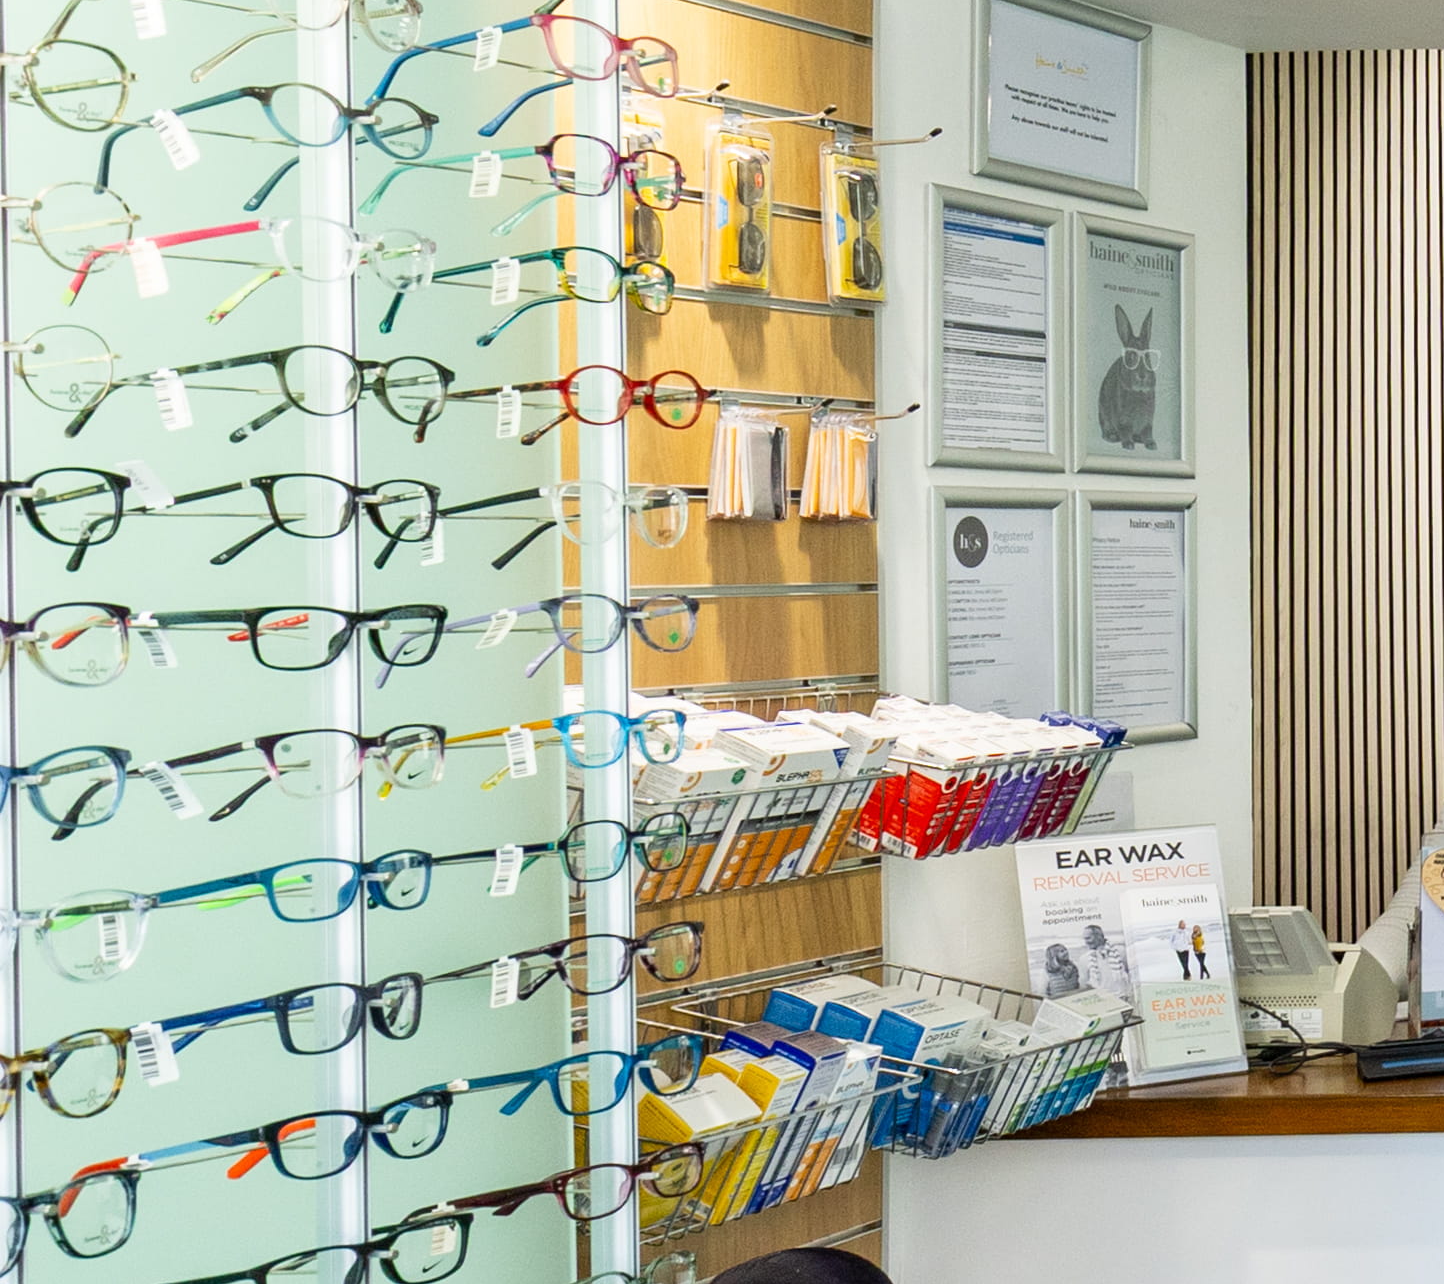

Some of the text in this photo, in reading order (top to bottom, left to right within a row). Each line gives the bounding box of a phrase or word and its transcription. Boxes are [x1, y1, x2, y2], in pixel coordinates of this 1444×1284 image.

[1056, 841, 1185, 869] EAR WAX
[1033, 862, 1212, 892] REMOVAL SERVICE
[1042, 913, 1103, 926] appointment
[1045, 906, 1084, 917] booking
[1151, 993, 1227, 1012] EAR WAX
[1157, 1007, 1224, 1022] REMOVAL
[924, 1028, 961, 1045] OPTASE
